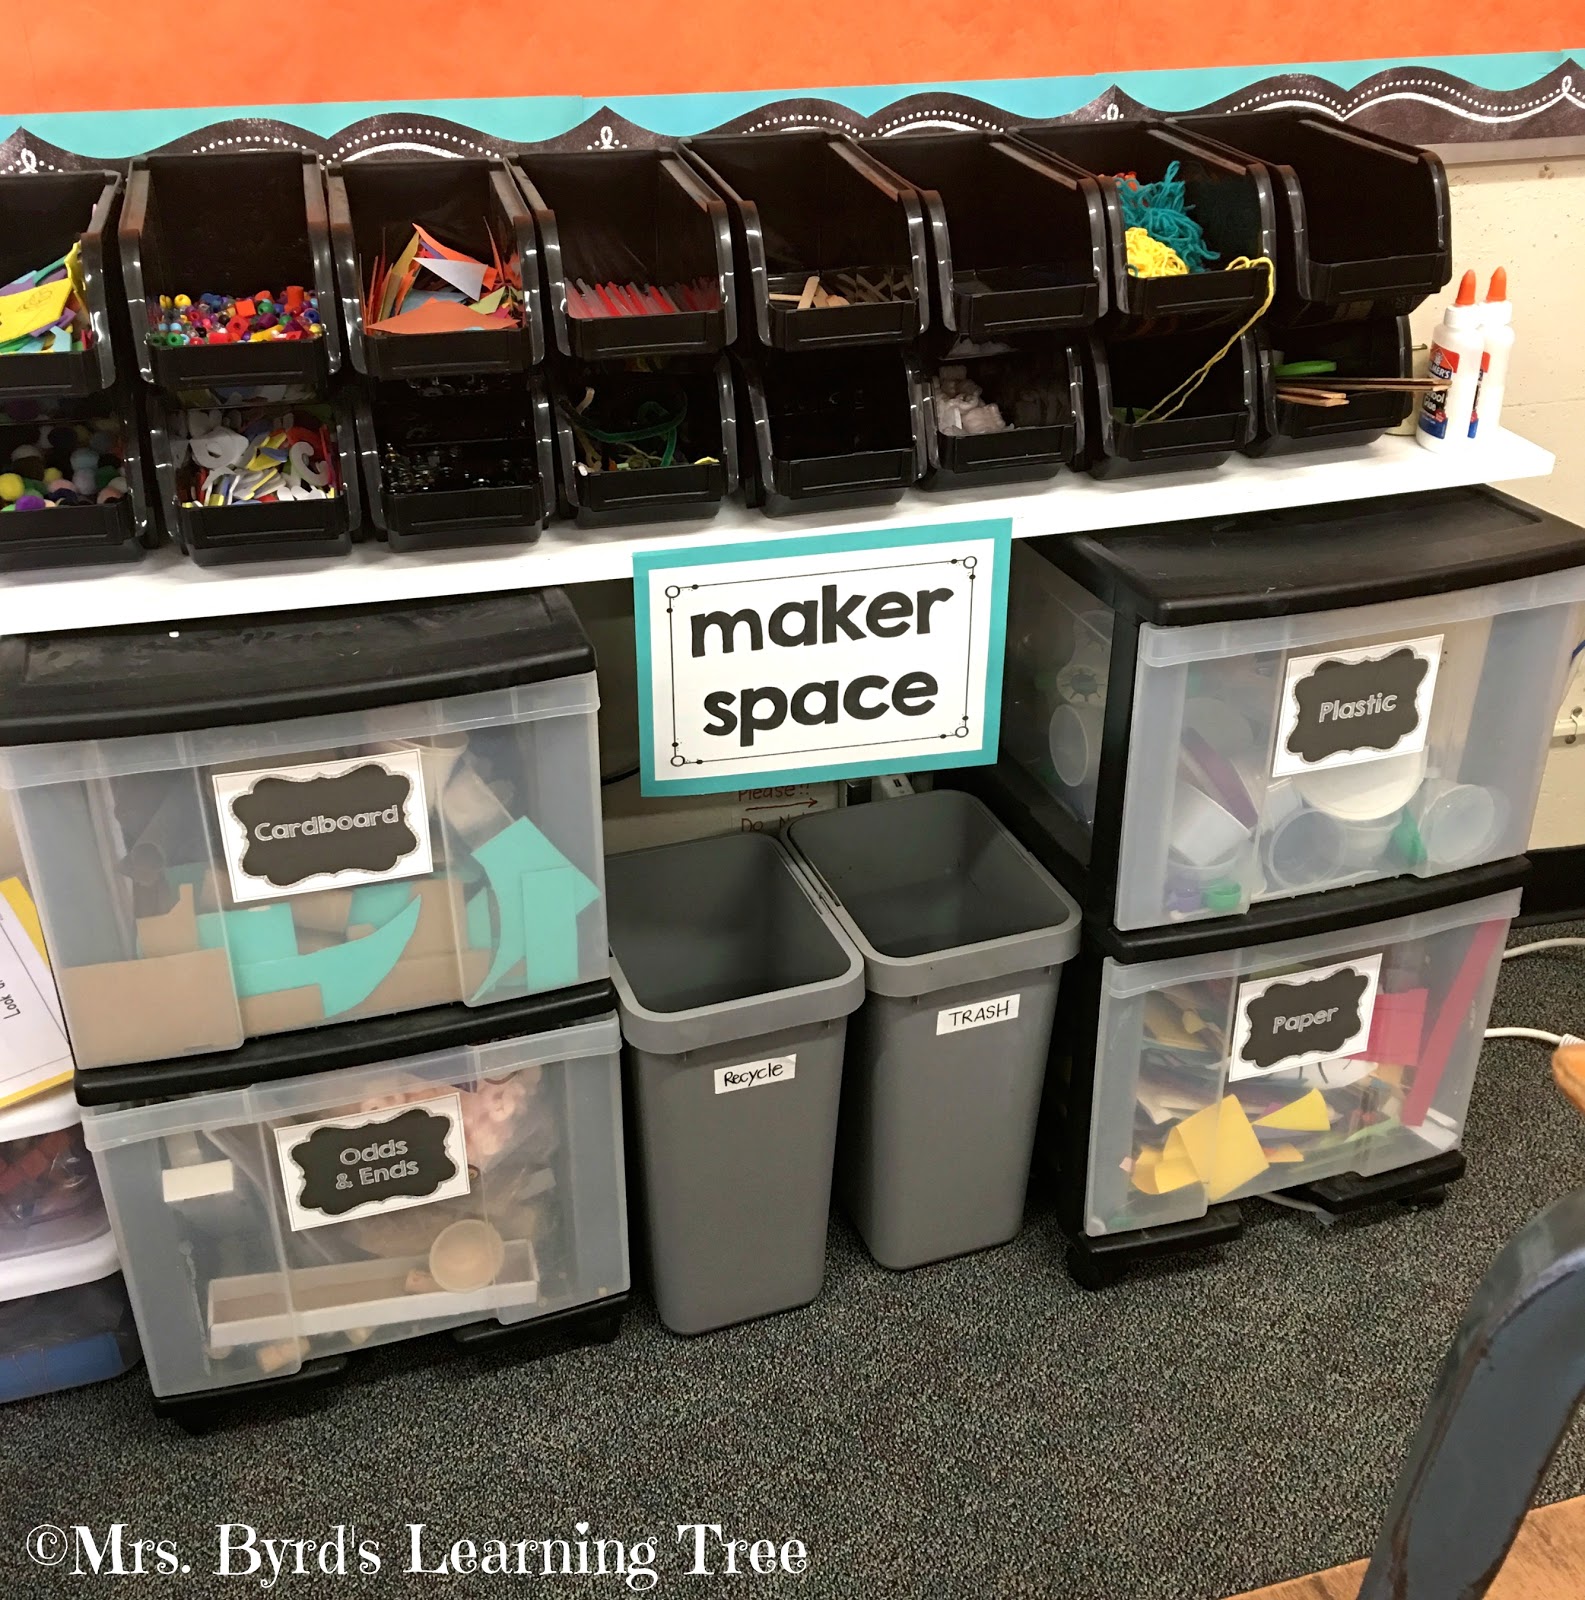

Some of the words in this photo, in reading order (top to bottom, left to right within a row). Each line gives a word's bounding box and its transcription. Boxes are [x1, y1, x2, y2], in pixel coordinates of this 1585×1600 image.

[1428, 362, 1451, 379] MER'S
[690, 584, 954, 658] maker
[703, 671, 938, 747] space
[1318, 692, 1398, 723] Plastic
[254, 805, 399, 841] Cardboard
[741, 817, 764, 832] Do
[2, 994, 21, 1020] Look
[948, 1000, 1010, 1027] TRASH
[1272, 1007, 1339, 1034] Paper
[723, 1062, 784, 1088] Recycle
[339, 1139, 408, 1165] Odds
[335, 1173, 353, 1190] &
[359, 1160, 420, 1186] Ends
